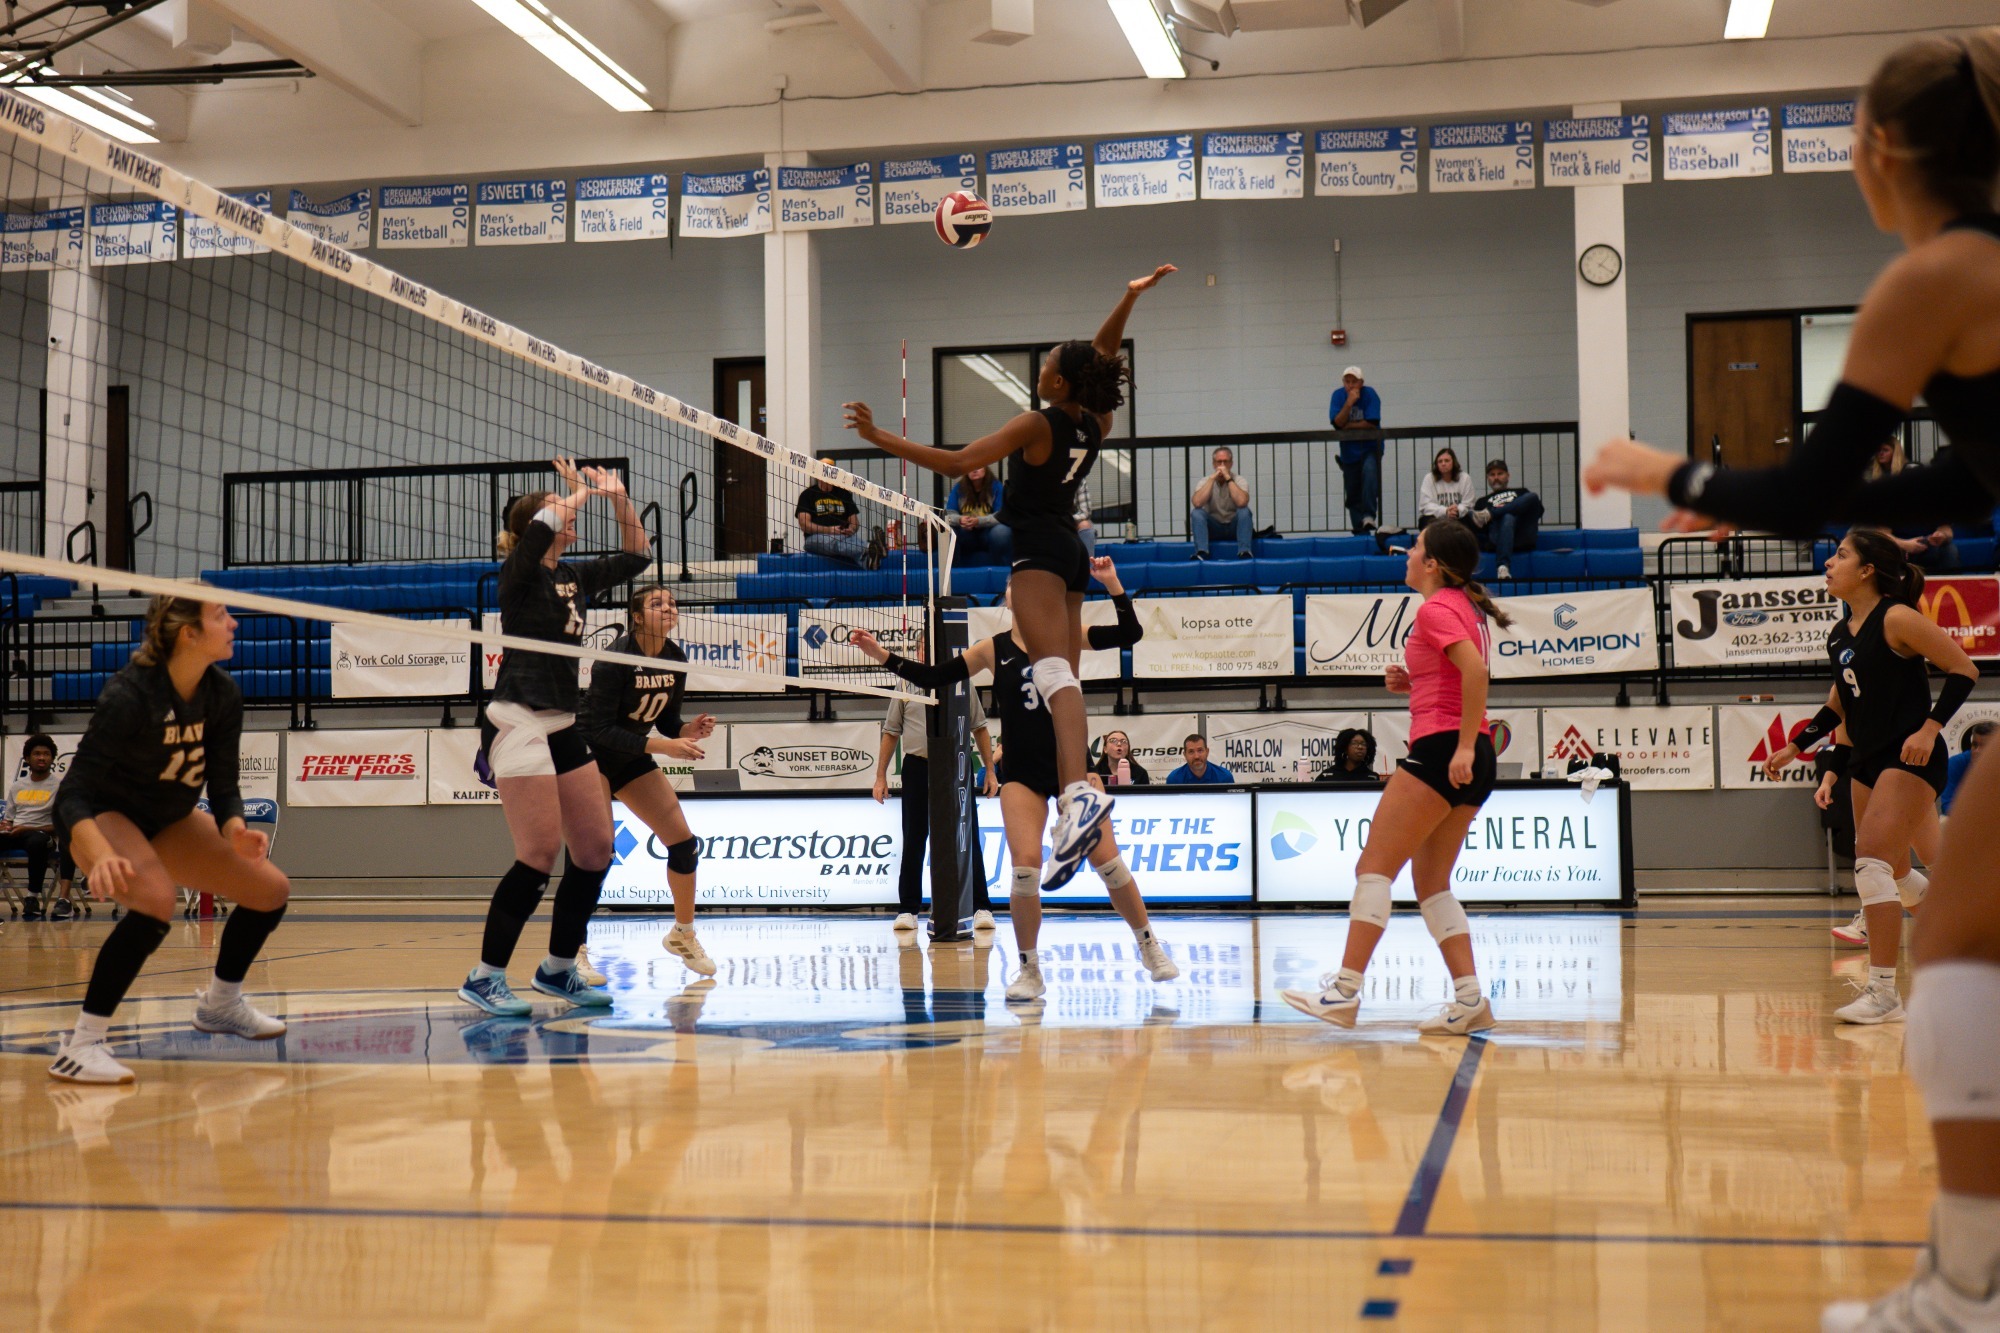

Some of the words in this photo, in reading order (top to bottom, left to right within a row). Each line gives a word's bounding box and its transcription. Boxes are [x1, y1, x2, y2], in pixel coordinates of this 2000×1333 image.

[1441, 125, 1508, 136] CONFERENCE
[1556, 119, 1624, 130] CONFERENCE
[1752, 107, 1769, 156] 2015
[1214, 135, 1278, 146] CONFERENCE
[1327, 131, 1389, 141] CONFERENCE
[1442, 134, 1504, 145] CHAMPIONS
[1632, 115, 1648, 163] 2015
[1106, 139, 1169, 152] CONFERENCE
[1215, 144, 1276, 154] CHAMPIONS
[1327, 139, 1386, 149] CHAMPIONS
[1400, 127, 1416, 174] 2014
[1515, 121, 1532, 169] 2015
[1668, 145, 1707, 157] Men's
[1787, 138, 1826, 150] Men's
[997, 151, 1028, 161] WORLD
[1030, 148, 1059, 159] SERIES
[1106, 149, 1167, 161] CHAMPIONS
[1177, 135, 1193, 182] 2014
[1286, 131, 1302, 179] 2014
[1550, 151, 1588, 162] Men's
[1668, 153, 1739, 171] Baseball
[106, 144, 163, 189] PANTHERS
[890, 160, 932, 170] REGIONAL
[1067, 145, 1083, 191] 2013
[1320, 162, 1357, 173] Men's
[1435, 158, 1482, 169] Women's
[1550, 161, 1579, 176] Track
[1583, 163, 1591, 176] &
[1595, 160, 1621, 175] Field
[891, 166, 942, 178] CHAMPIONS
[960, 154, 975, 193] 013
[1100, 173, 1146, 184] Women's
[1208, 166, 1244, 177] Men's
[1436, 168, 1464, 183] Track
[1468, 169, 1476, 181] &
[1480, 166, 1505, 181] Field
[587, 177, 645, 189] CONFERENCE
[855, 162, 871, 207] 2013
[1208, 176, 1236, 190] Track
[1239, 177, 1247, 190] &
[1250, 175, 1275, 190] Field
[1321, 172, 1350, 187] Cross
[1352, 171, 1395, 189] Country
[390, 188, 422, 197] REGULAR
[424, 186, 451, 196] SEASON
[488, 184, 526, 200] SWEET
[531, 183, 544, 198] 16
[586, 187, 642, 197] CHAMPIONS
[753, 169, 770, 215] 2013
[885, 190, 920, 201] Men's
[992, 182, 1027, 194] Men's
[1101, 182, 1130, 198] Track
[1132, 184, 1140, 196] &
[1143, 180, 1167, 195] Field
[551, 180, 566, 225] 2013
[651, 174, 666, 220] 2013
[782, 198, 817, 209] Men's
[992, 190, 1056, 207] Baseball
[358, 189, 371, 232] 2012
[453, 185, 468, 229] 2013
[581, 209, 613, 220] Men's
[686, 205, 727, 217] Women's
[782, 205, 844, 222] Baseball
[885, 199, 938, 215] Baseba
[216, 195, 266, 235] PANTHERS
[383, 217, 415, 227] Men's
[480, 214, 514, 224] Men's
[687, 215, 713, 229] Track
[716, 216, 723, 229] &
[725, 213, 749, 230] Field
[162, 202, 177, 244] 2012
[480, 222, 547, 237] Basketball
[582, 219, 606, 232] Track
[609, 219, 616, 231] &
[620, 217, 643, 231] Field
[382, 225, 448, 241] Basketball
[95, 241, 152, 257] Baseball
[1061, 448, 1089, 484] 7
[1677, 587, 1837, 640] Janssen
[1731, 612, 1762, 626] Ford
[1772, 613, 1785, 622] of
[1792, 610, 1838, 623] YORK
[1181, 617, 1220, 632] kopsa
[1225, 617, 1253, 629] otte
[1945, 625, 1996, 637] nald's
[1499, 633, 1640, 657] CHAMPION
[1732, 629, 1829, 647] 402-362-3326
[679, 639, 742, 661] lmart
[1171, 650, 1256, 660] www.kopsaotte.com
[1725, 644, 1827, 659] janssenautogroup.co
[354, 655, 378, 666] York
[381, 654, 404, 665] Cold
[408, 653, 448, 666] Storage,
[451, 655, 467, 664] LLC
[1149, 664, 1168, 672] TOLL
[1208, 663, 1213, 671] 1
[1216, 662, 1234, 671] 800
[1236, 662, 1253, 671] 975
[1256, 661, 1279, 670] 4829
[1542, 655, 1595, 667] HOMES
[635, 674, 676, 689] BRAVES
[1843, 668, 1861, 698] 9
[628, 692, 669, 723] 10
[1967, 709, 1999, 720] DENTA
[1597, 727, 1710, 746] ELEVATE
[1225, 739, 1283, 757] HARLOW
[1301, 739, 1336, 757] HOME
[303, 754, 413, 765] PENNER'S
[777, 751, 827, 762] SUNSET
[831, 750, 869, 761] BOWL
[1616, 751, 1690, 761] ROOFING
[160, 747, 207, 788] 12
[264, 757, 277, 771] LLC
[661, 766, 694, 775] ARMS
[1221, 761, 1276, 773] COMMERCIAL
[1620, 766, 1691, 775] teroofers.com
[301, 765, 349, 782] TIRE
[354, 764, 416, 781] PROS
[453, 791, 491, 800] KALIFF
[1130, 819, 1161, 835] OF
[1168, 818, 1215, 835] THE
[1335, 818, 1372, 851] YO
[1465, 816, 1597, 850] ENERAL
[820, 864, 891, 876] BANK
[1456, 866, 1489, 883] Our
[1493, 866, 1541, 883] Focus
[1546, 866, 1561, 882] is
[1567, 866, 1602, 882] You.
[599, 886, 626, 900] oud
[702, 886, 717, 899] of
[721, 886, 753, 899] York
[758, 885, 831, 902] University
